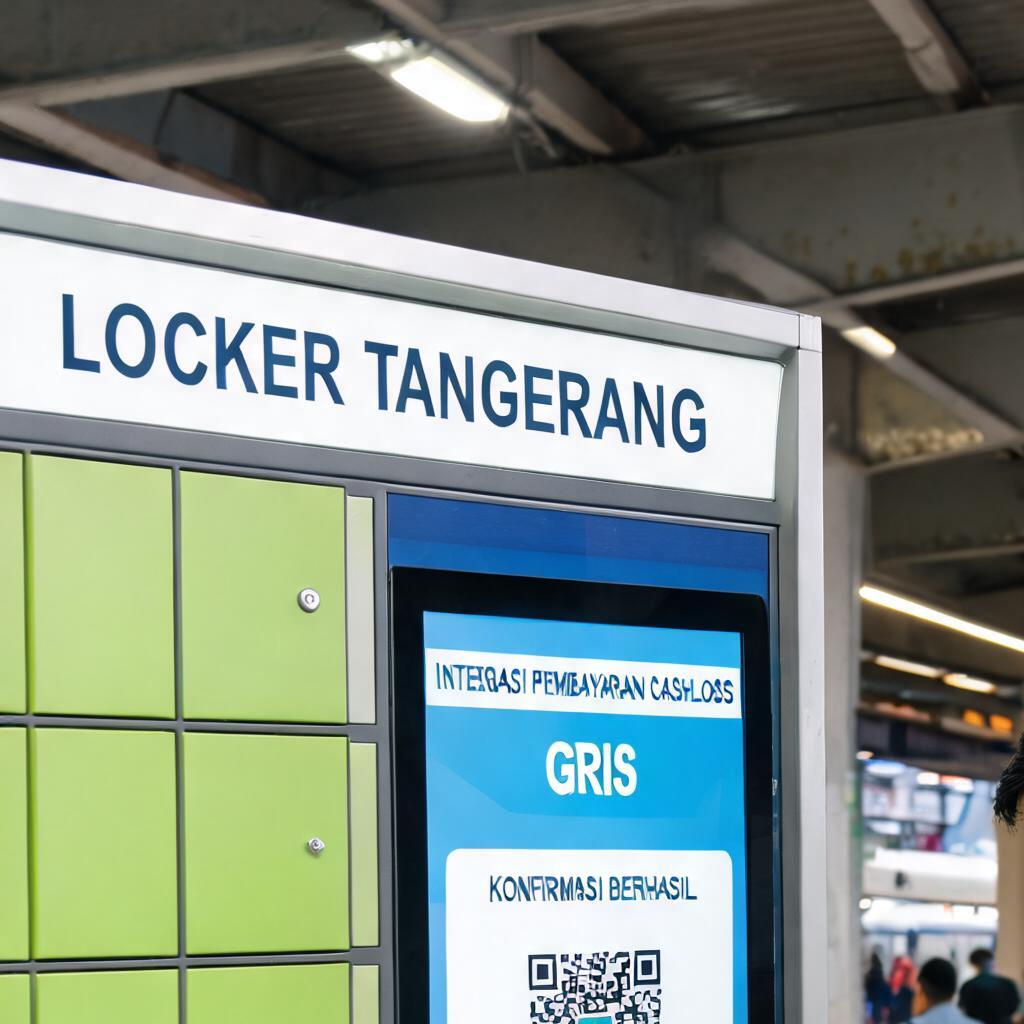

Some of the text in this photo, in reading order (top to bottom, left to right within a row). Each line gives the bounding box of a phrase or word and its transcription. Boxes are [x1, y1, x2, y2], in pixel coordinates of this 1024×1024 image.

[62, 293, 707, 454] LOCKER TANGERANG
[545, 740, 638, 797] GRIS
[489, 874, 698, 902] KONFIRMASI BERHASIL
